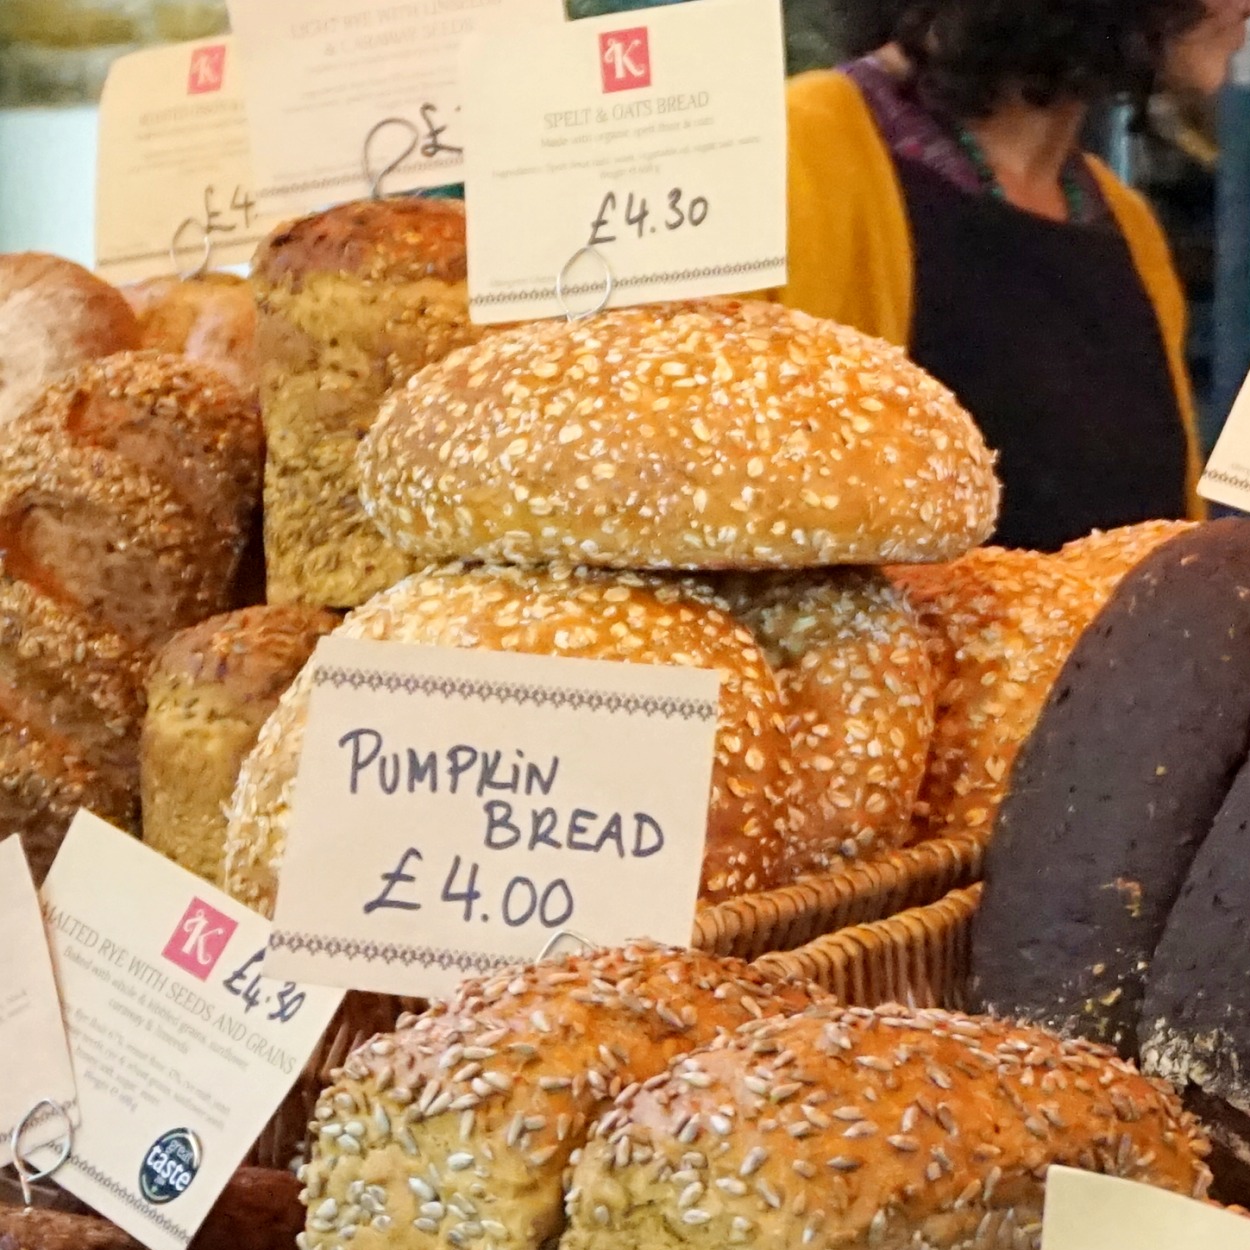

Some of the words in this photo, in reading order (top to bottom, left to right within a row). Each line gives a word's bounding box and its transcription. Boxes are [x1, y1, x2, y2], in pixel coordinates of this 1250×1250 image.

[603, 36, 648, 81] K
[543, 107, 592, 130] SPELT
[594, 106, 608, 123] &
[611, 98, 653, 120] OATS
[656, 90, 710, 114] BREAD
[589, 187, 708, 245] £4.30
[482, 800, 665, 859] BREAD
[363, 847, 575, 928] £4.00
[181, 907, 225, 967] K
[96, 937, 131, 969] RYE
[124, 956, 170, 993] WITH
[163, 980, 218, 1023] SEEDS
[210, 1010, 250, 1044] AND
[242, 1030, 299, 1076] GRAINS
[147, 1145, 191, 1191] taste
